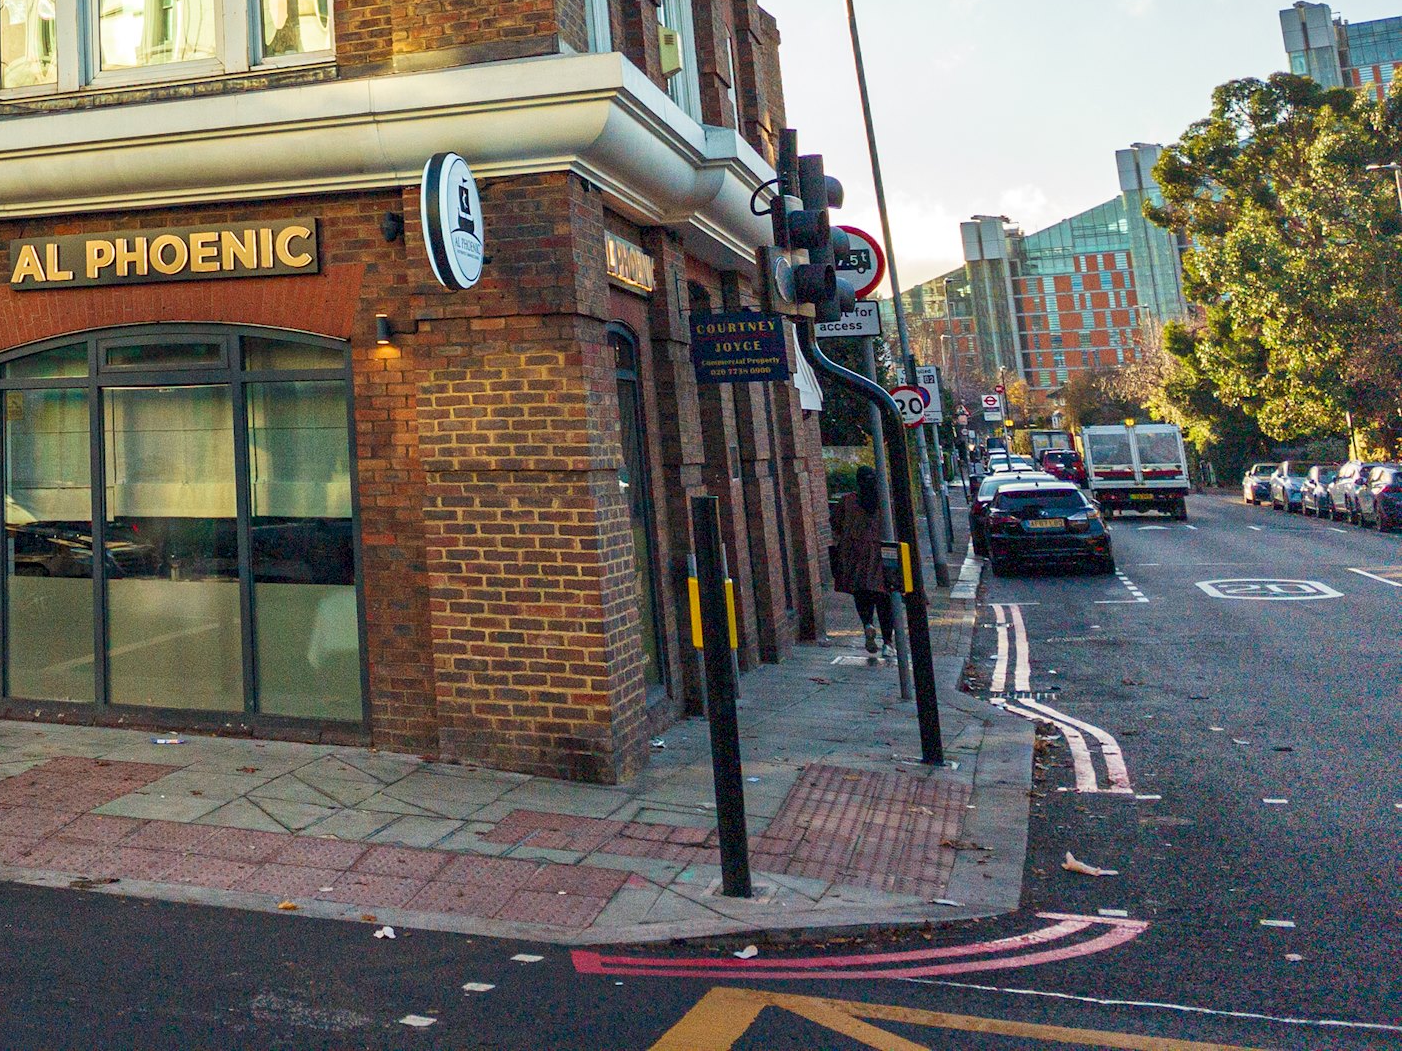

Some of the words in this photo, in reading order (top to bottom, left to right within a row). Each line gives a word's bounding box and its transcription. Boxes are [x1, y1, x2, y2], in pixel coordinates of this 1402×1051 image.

[10, 243, 74, 284] AL
[85, 226, 314, 279] PHOENIC
[855, 307, 873, 318] for
[696, 320, 775, 334] COURTNEY
[819, 322, 863, 332] access
[714, 340, 762, 353] JOYCE
[701, 358, 745, 366] Commercial
[747, 356, 780, 366] Property
[710, 368, 726, 376] 020
[894, 397, 923, 415] 20
[1217, 584, 1318, 594] 20
